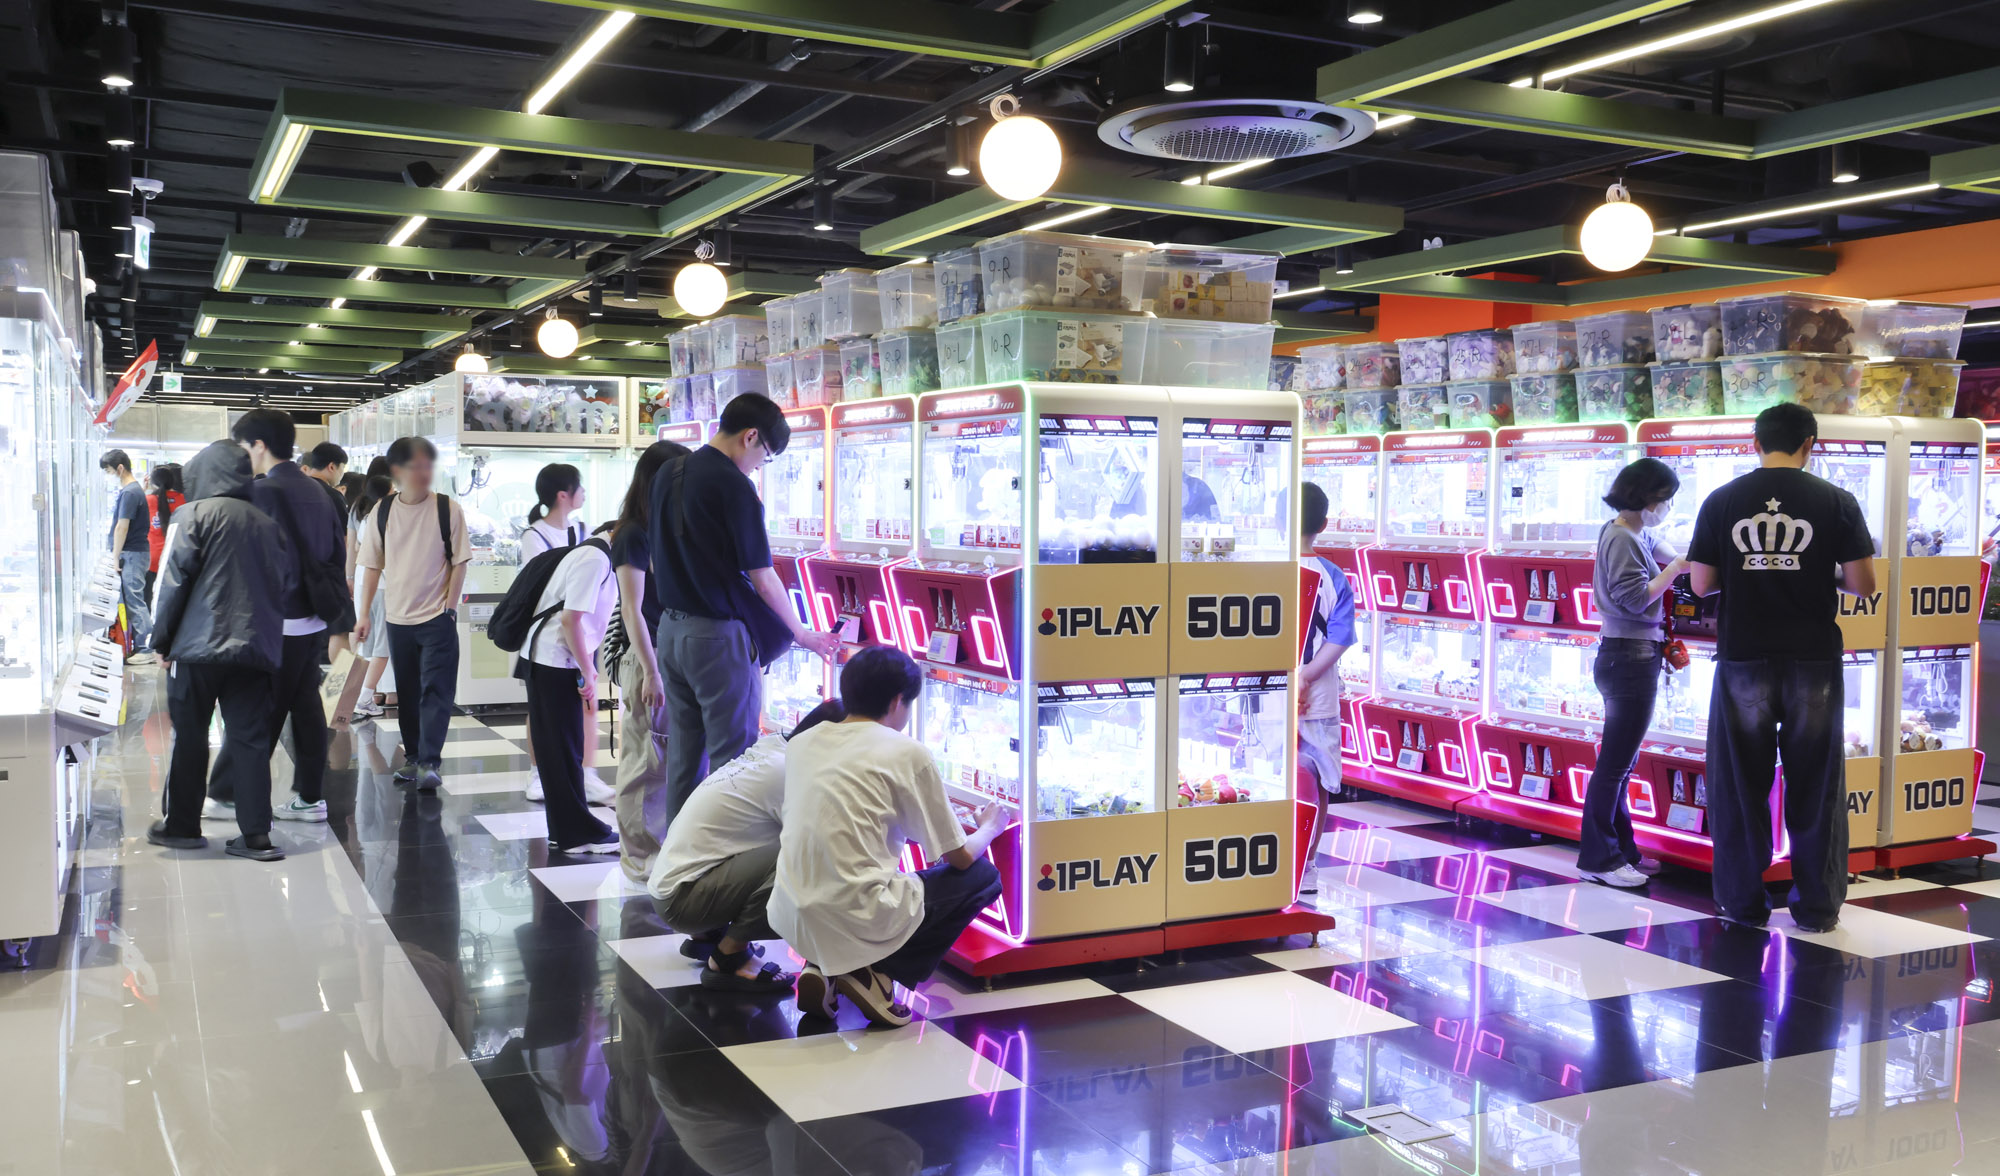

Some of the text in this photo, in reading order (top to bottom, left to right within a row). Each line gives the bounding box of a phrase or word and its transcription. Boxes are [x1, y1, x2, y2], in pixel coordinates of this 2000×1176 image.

[988, 256, 1012, 284] 9-R
[989, 333, 1015, 358] 10-R
[1040, 418, 1061, 428] OOL
[1063, 419, 1094, 430] COOL
[1094, 420, 1125, 430] COOL
[1210, 424, 1237, 434] COOL
[1240, 425, 1266, 435] COOL
[1270, 426, 1292, 435] COO
[1910, 585, 1971, 616] 1000
[1057, 605, 1160, 637] 1PLAY
[1187, 595, 1281, 639] 500
[1037, 687, 1059, 697] OOL
[1061, 685, 1092, 695] COOL
[1093, 683, 1123, 694] COOL
[1206, 677, 1234, 687] COOL
[1236, 676, 1263, 686] COOL
[1266, 675, 1288, 685] COO
[1904, 777, 1965, 812] 1000
[1056, 853, 1159, 892] 1PLAY
[1184, 833, 1279, 883] 500
